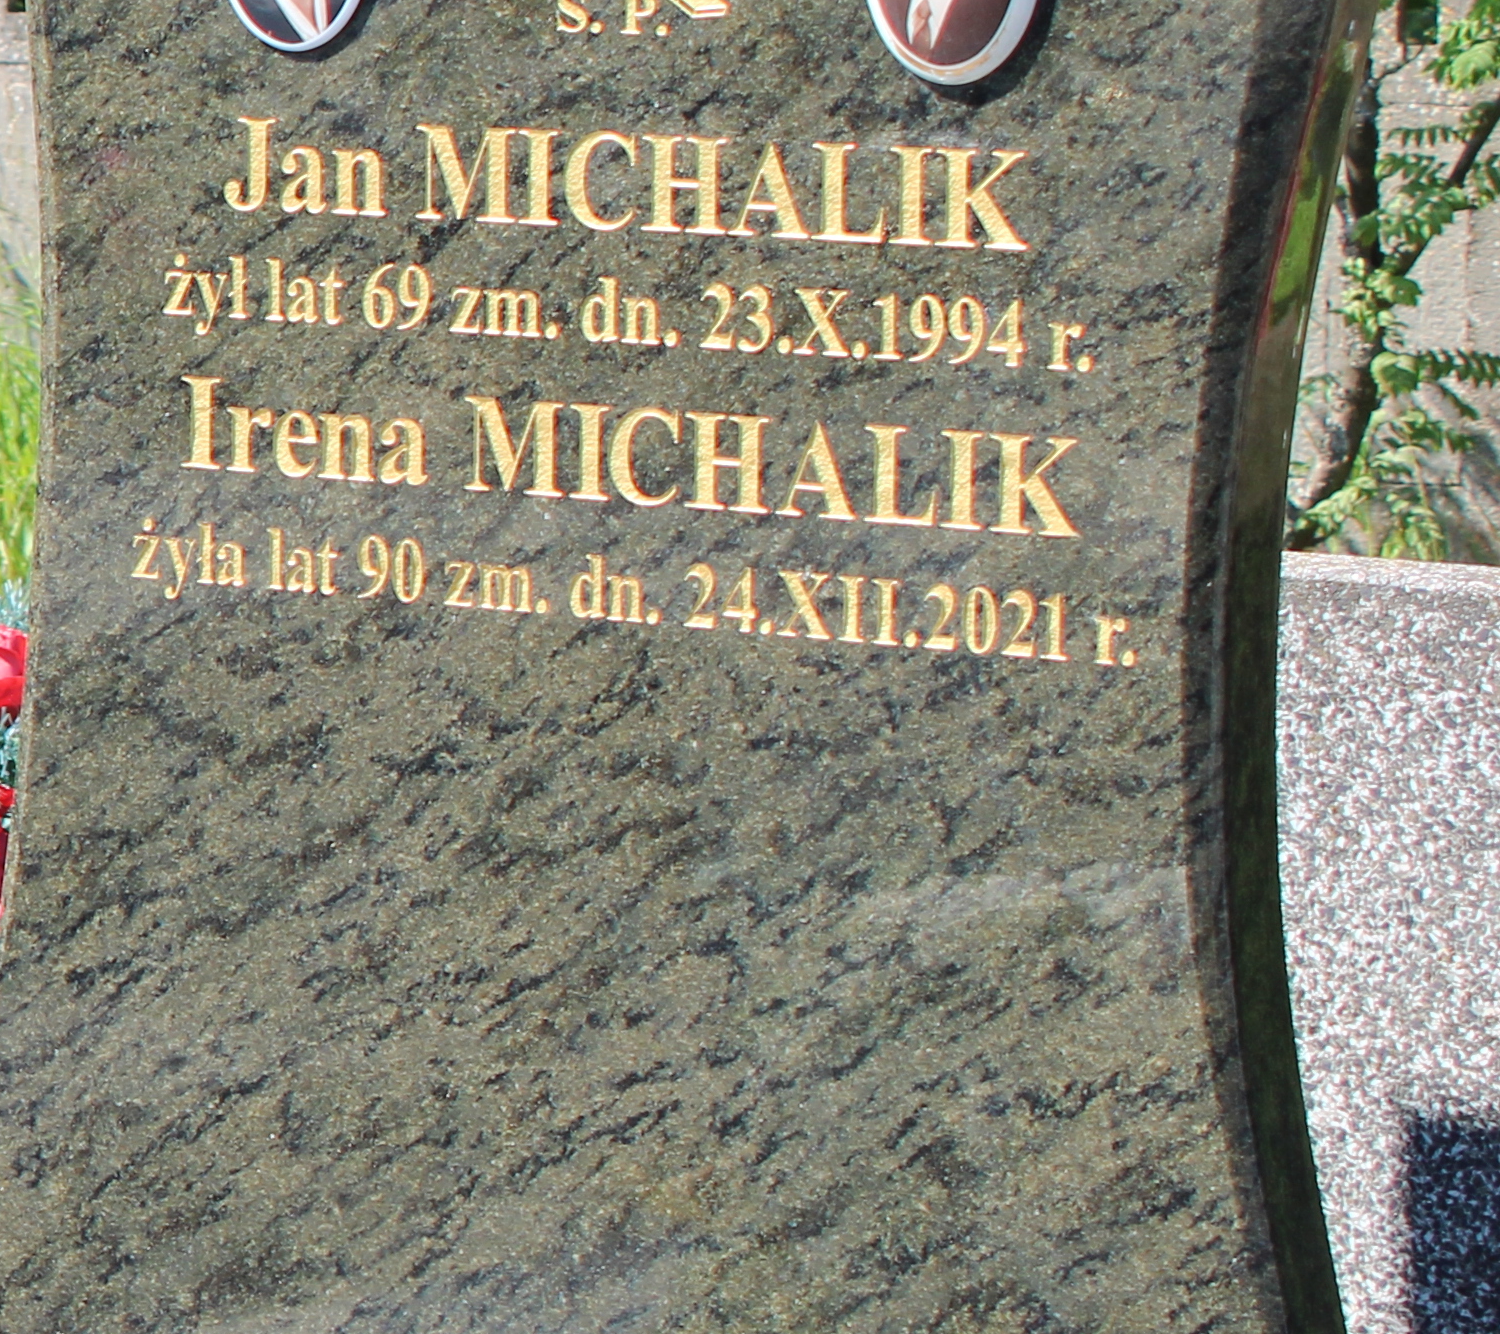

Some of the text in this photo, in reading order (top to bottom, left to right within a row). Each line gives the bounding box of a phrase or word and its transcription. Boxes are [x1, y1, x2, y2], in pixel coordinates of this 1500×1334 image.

[226, 114, 1032, 253] Jan MICHALIK
[166, 252, 1096, 373] żył lat 69 zm. dn. 23.X.1994 r.
[180, 375, 1081, 538] Irena MICHALIK
[134, 516, 1140, 668] żyła lat 90 zm. dn. 24.XII.2021 r.
